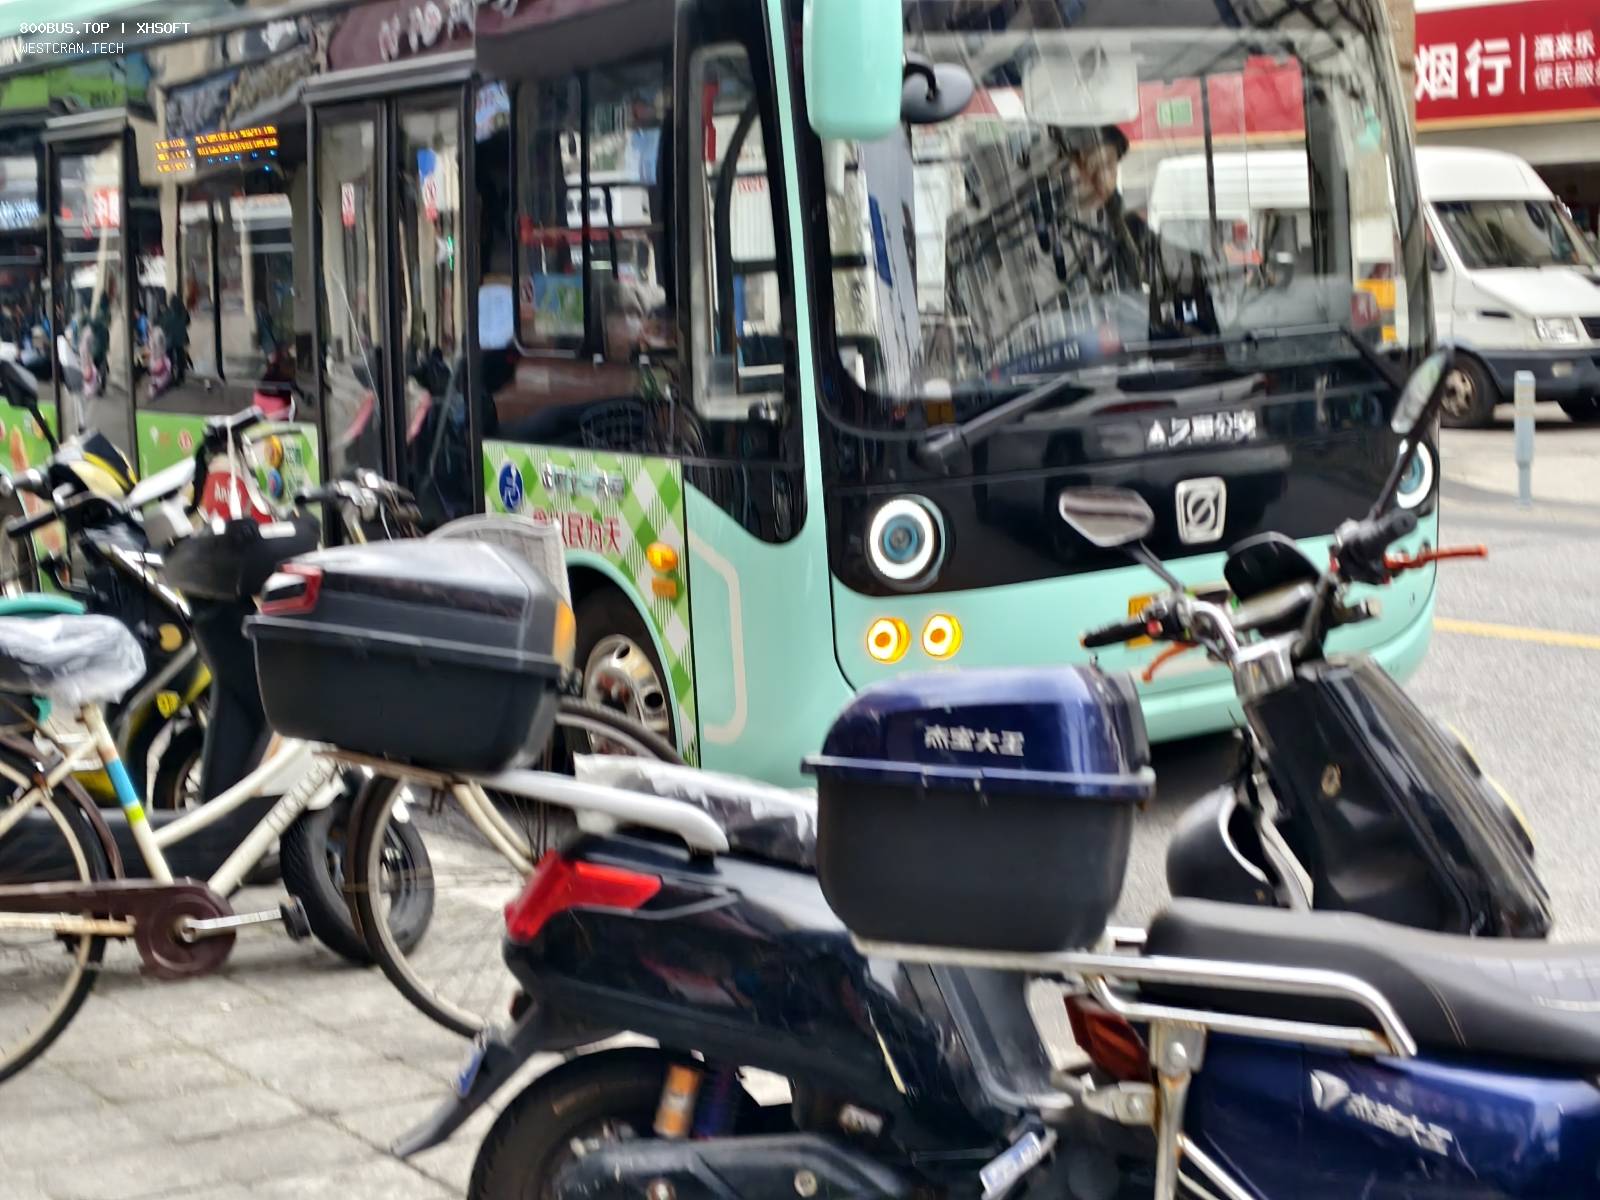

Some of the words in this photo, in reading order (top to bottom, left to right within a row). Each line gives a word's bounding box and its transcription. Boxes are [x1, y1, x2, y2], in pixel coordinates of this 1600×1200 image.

[1414, 37, 1512, 102] 烟行
[1534, 60, 1600, 90] 便民服
